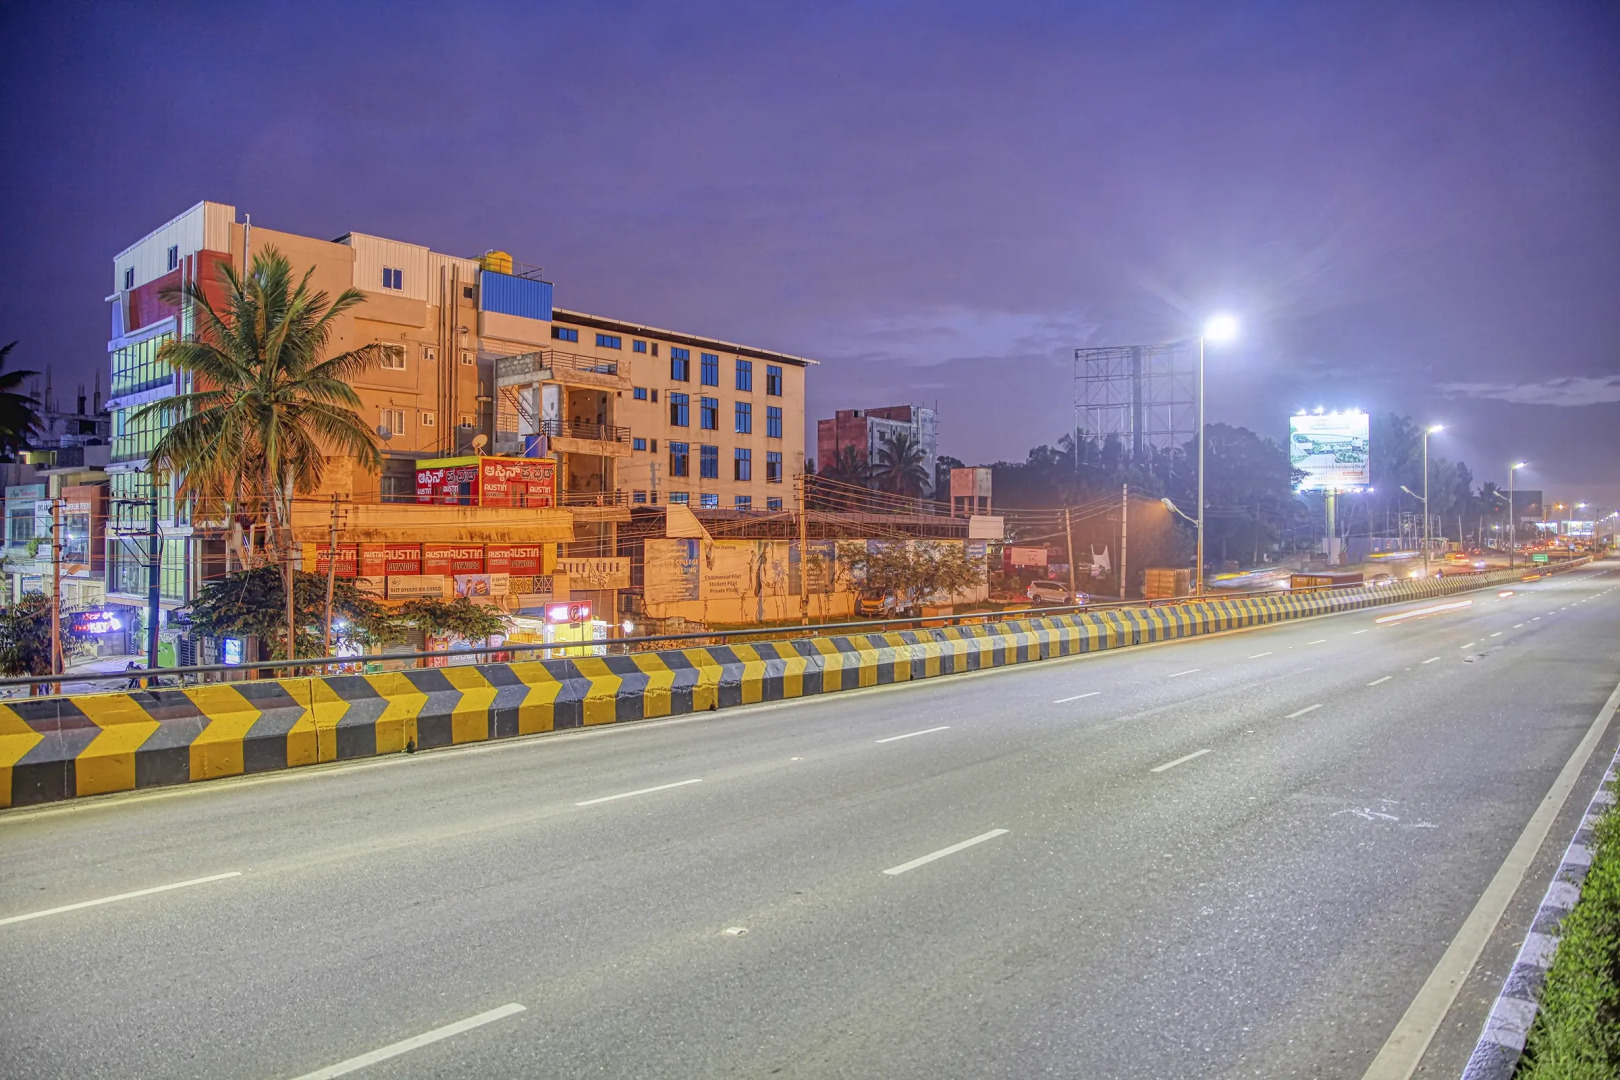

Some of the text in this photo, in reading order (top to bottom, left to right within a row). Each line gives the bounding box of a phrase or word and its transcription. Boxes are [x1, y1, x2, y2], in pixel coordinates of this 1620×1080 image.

[484, 483, 508, 492] AUSTIN
[529, 486, 552, 494] AUSTIN
[384, 550, 420, 560] AUSTIN
[425, 551, 451, 559] AUSTIN
[450, 549, 483, 559] AUSTIN
[488, 550, 510, 558] AUSTIN
[509, 548, 539, 558] AUSTIN
[387, 562, 417, 571] PLYWOOD
[451, 561, 480, 570] PLYWOOD
